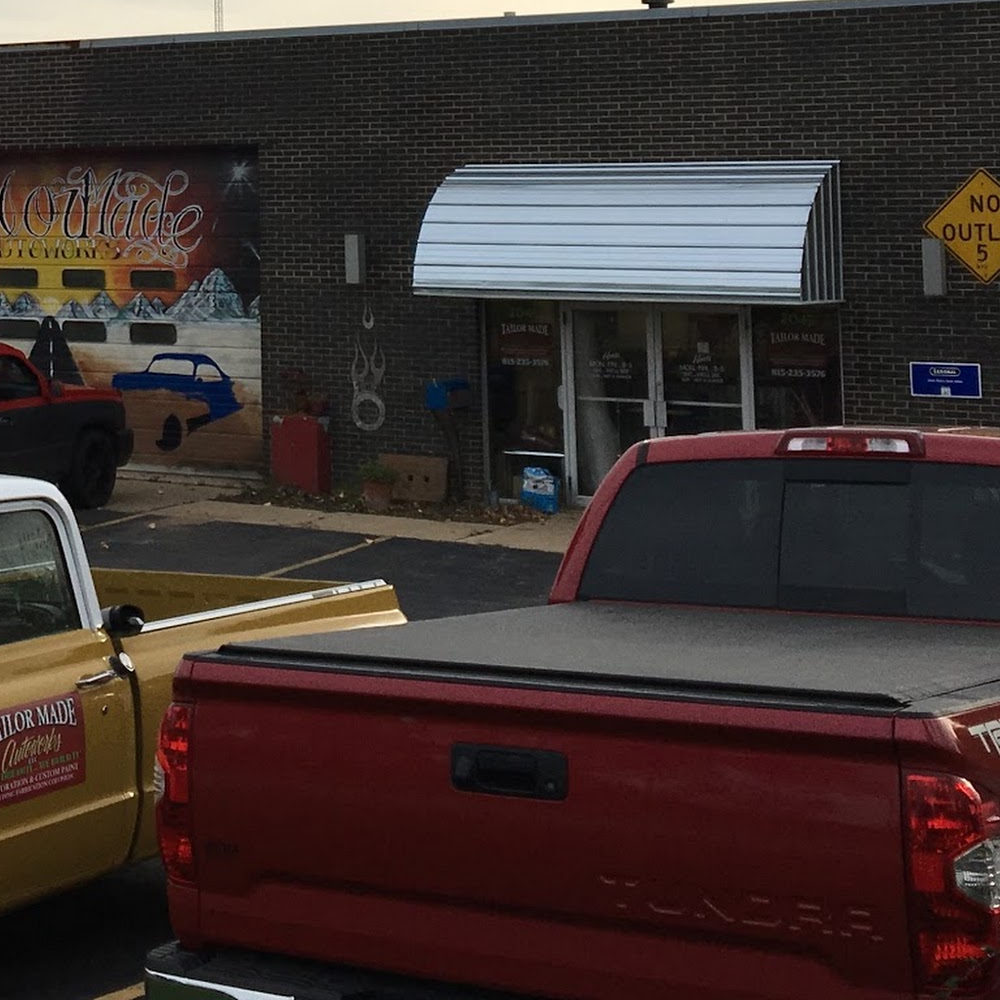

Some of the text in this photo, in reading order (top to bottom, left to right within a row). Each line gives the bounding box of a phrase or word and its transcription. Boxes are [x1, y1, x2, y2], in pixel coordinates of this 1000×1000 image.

[970, 194, 1000, 212] NO
[943, 223, 1000, 241] OUTL
[977, 243, 988, 262] 5
[501, 323, 549, 336] TAILOR MADE
[771, 332, 826, 346] TAILOR MADE
[36, 697, 77, 726] MADE
